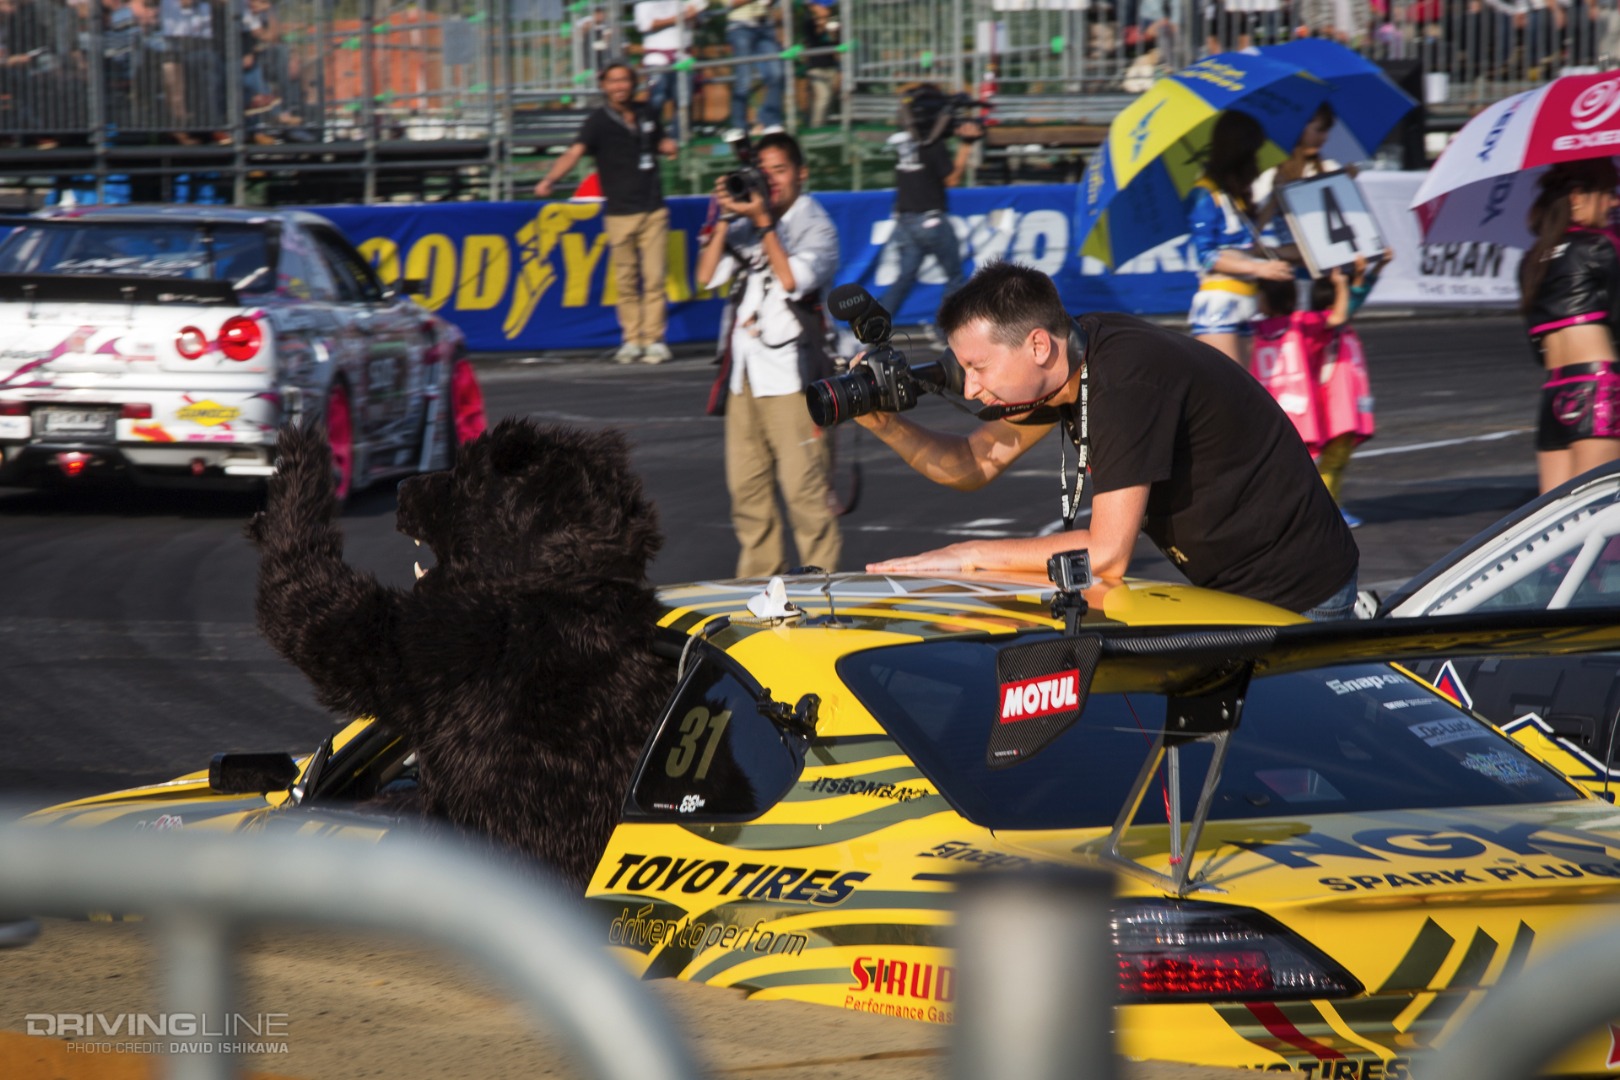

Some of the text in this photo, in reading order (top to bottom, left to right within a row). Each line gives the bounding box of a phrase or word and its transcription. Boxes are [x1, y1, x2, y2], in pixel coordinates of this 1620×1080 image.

[1320, 185, 1358, 253] 4
[1002, 676, 1077, 718] MOTUL
[665, 705, 732, 782] 31
[1221, 822, 1606, 869] NGK
[604, 853, 871, 906] TOYO TIRES
[1319, 868, 1486, 892] SPARK
[844, 995, 924, 1021] Performance
